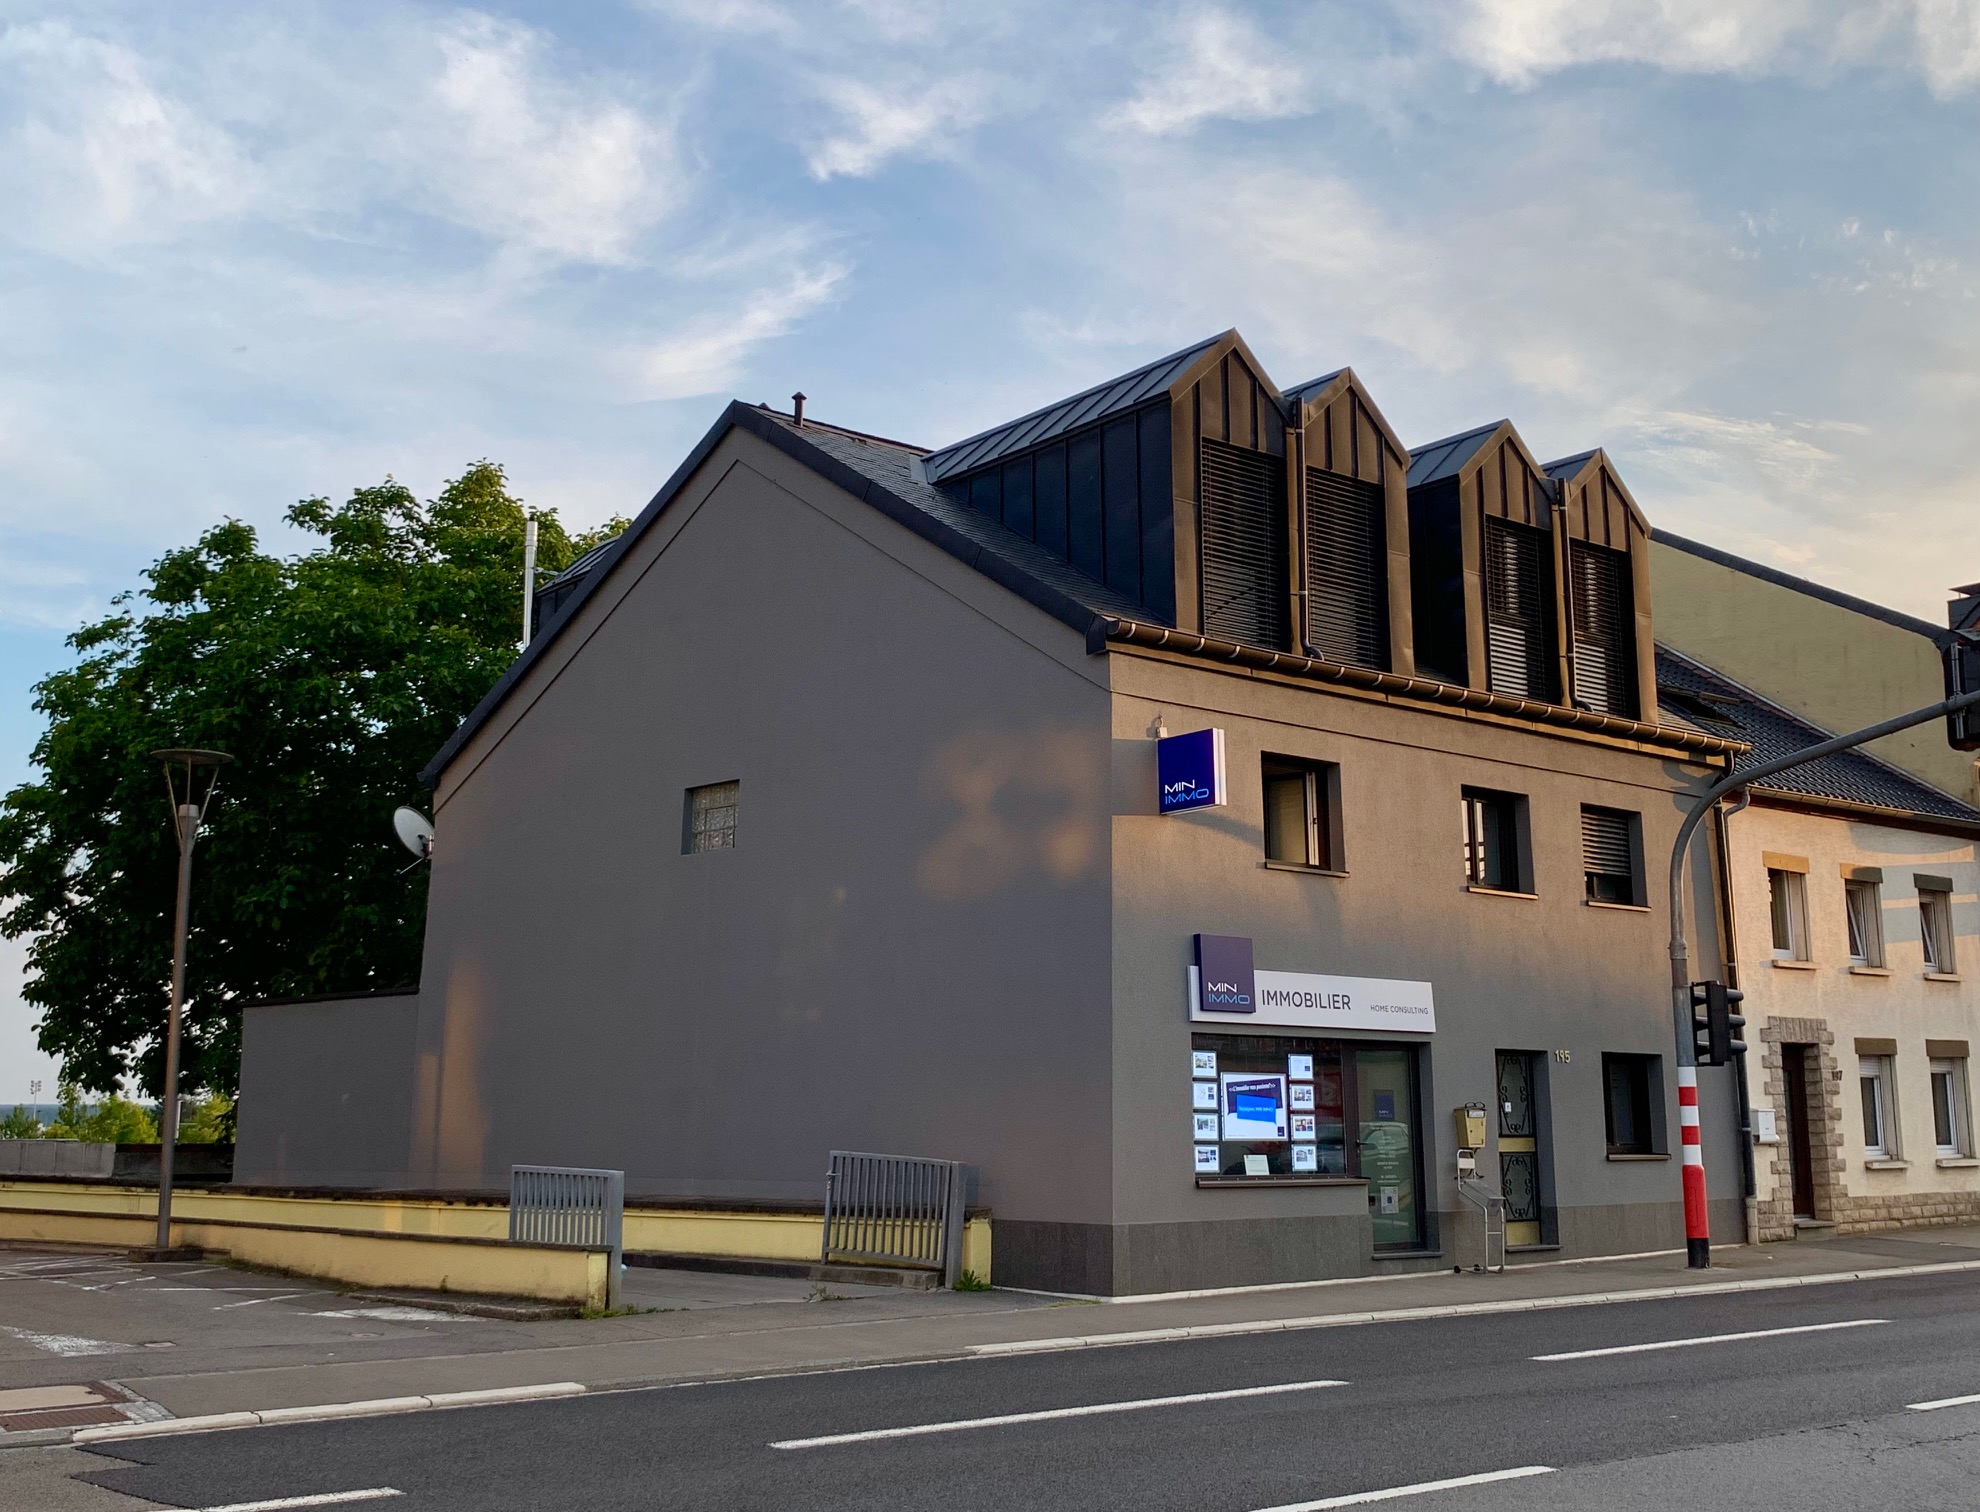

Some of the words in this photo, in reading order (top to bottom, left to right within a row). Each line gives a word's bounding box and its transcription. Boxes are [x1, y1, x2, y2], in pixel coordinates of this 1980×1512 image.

[1164, 779, 1195, 794] MIN
[1165, 788, 1210, 804] IMMO
[1208, 981, 1237, 992] MIN
[1208, 993, 1250, 1005] IMMO
[1261, 989, 1351, 1010] IMMOBILIER
[1370, 1004, 1389, 1013] HOME
[1390, 1006, 1428, 1015] CONSULTING
[1554, 1049, 1571, 1063] 195
